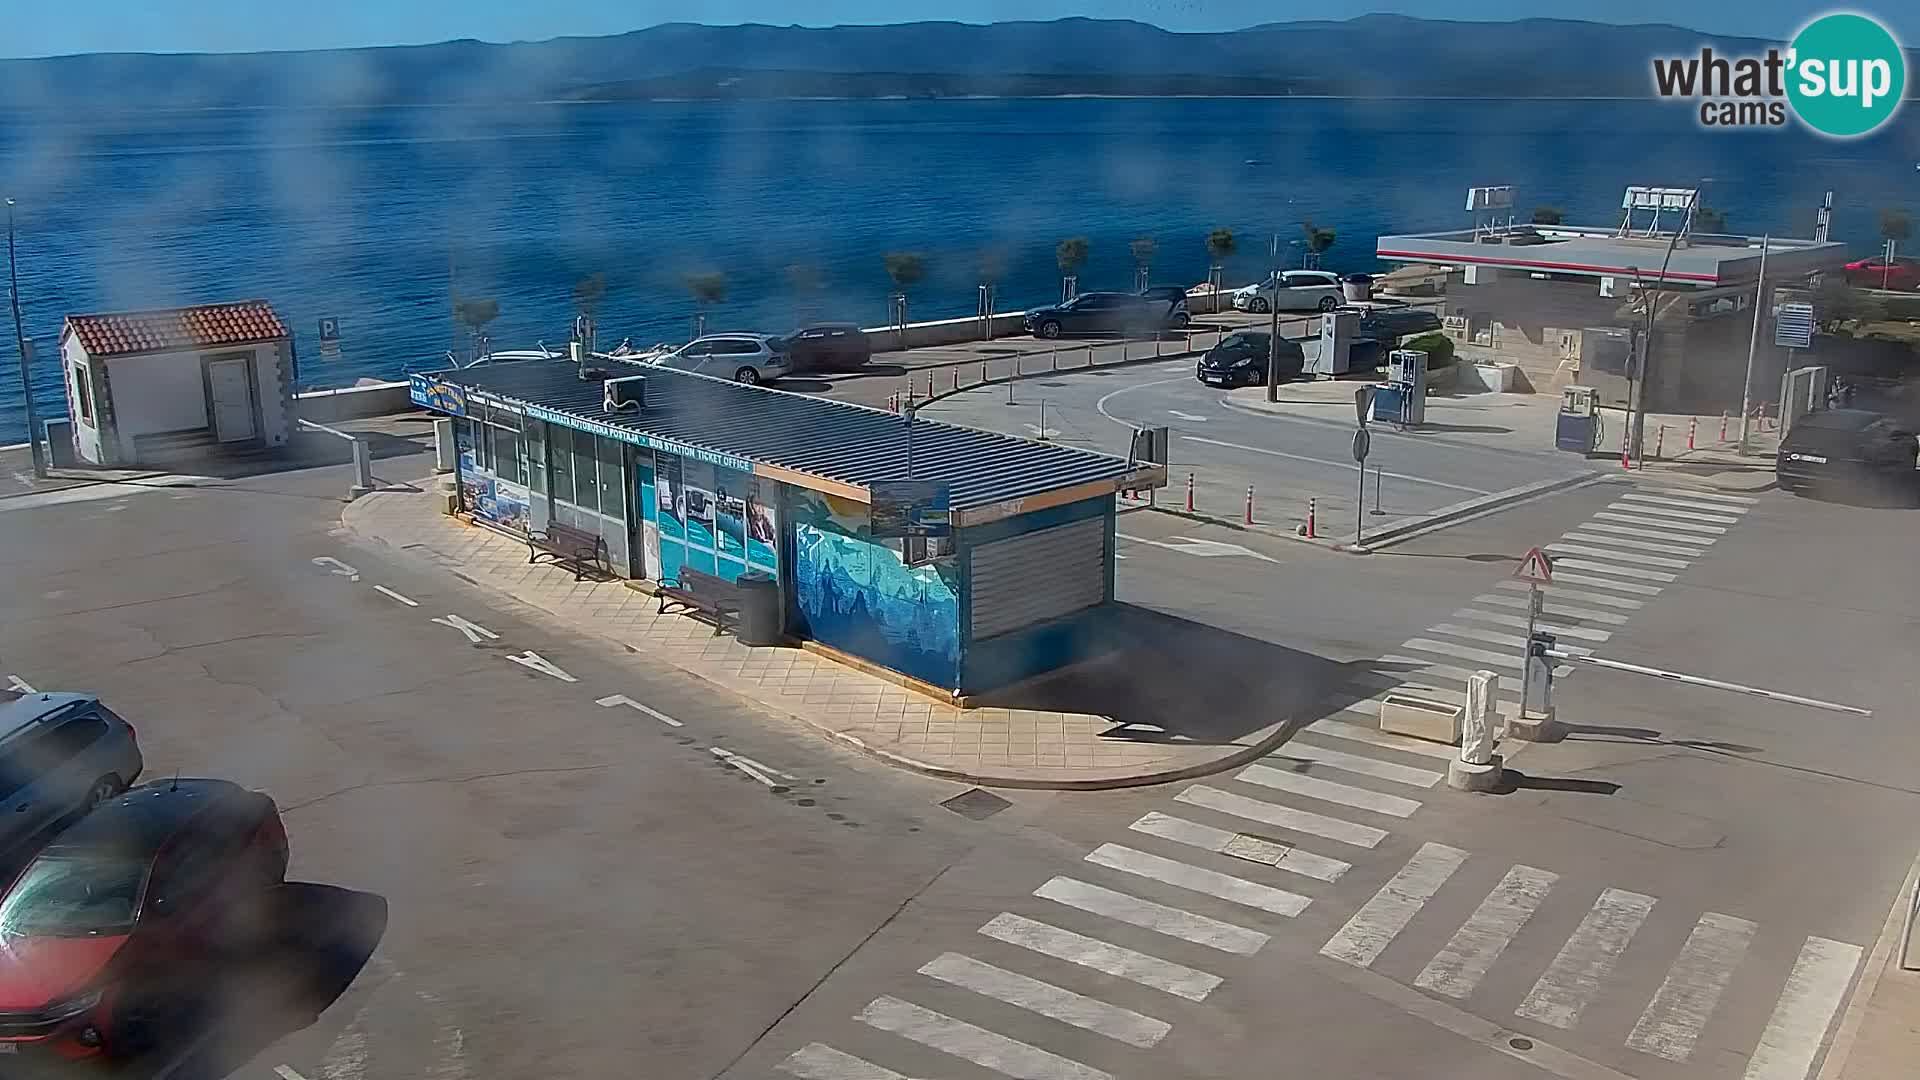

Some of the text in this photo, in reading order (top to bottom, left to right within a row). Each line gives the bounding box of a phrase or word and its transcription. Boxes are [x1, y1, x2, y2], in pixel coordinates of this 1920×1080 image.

[323, 320, 334, 337] P
[571, 417, 609, 436] AUTOBUSNA
[609, 428, 640, 444] POSTAJA
[648, 437, 663, 449] BUS
[664, 441, 696, 457] STATION
[697, 449, 722, 464] TICKET
[723, 456, 750, 471] OFFICE
